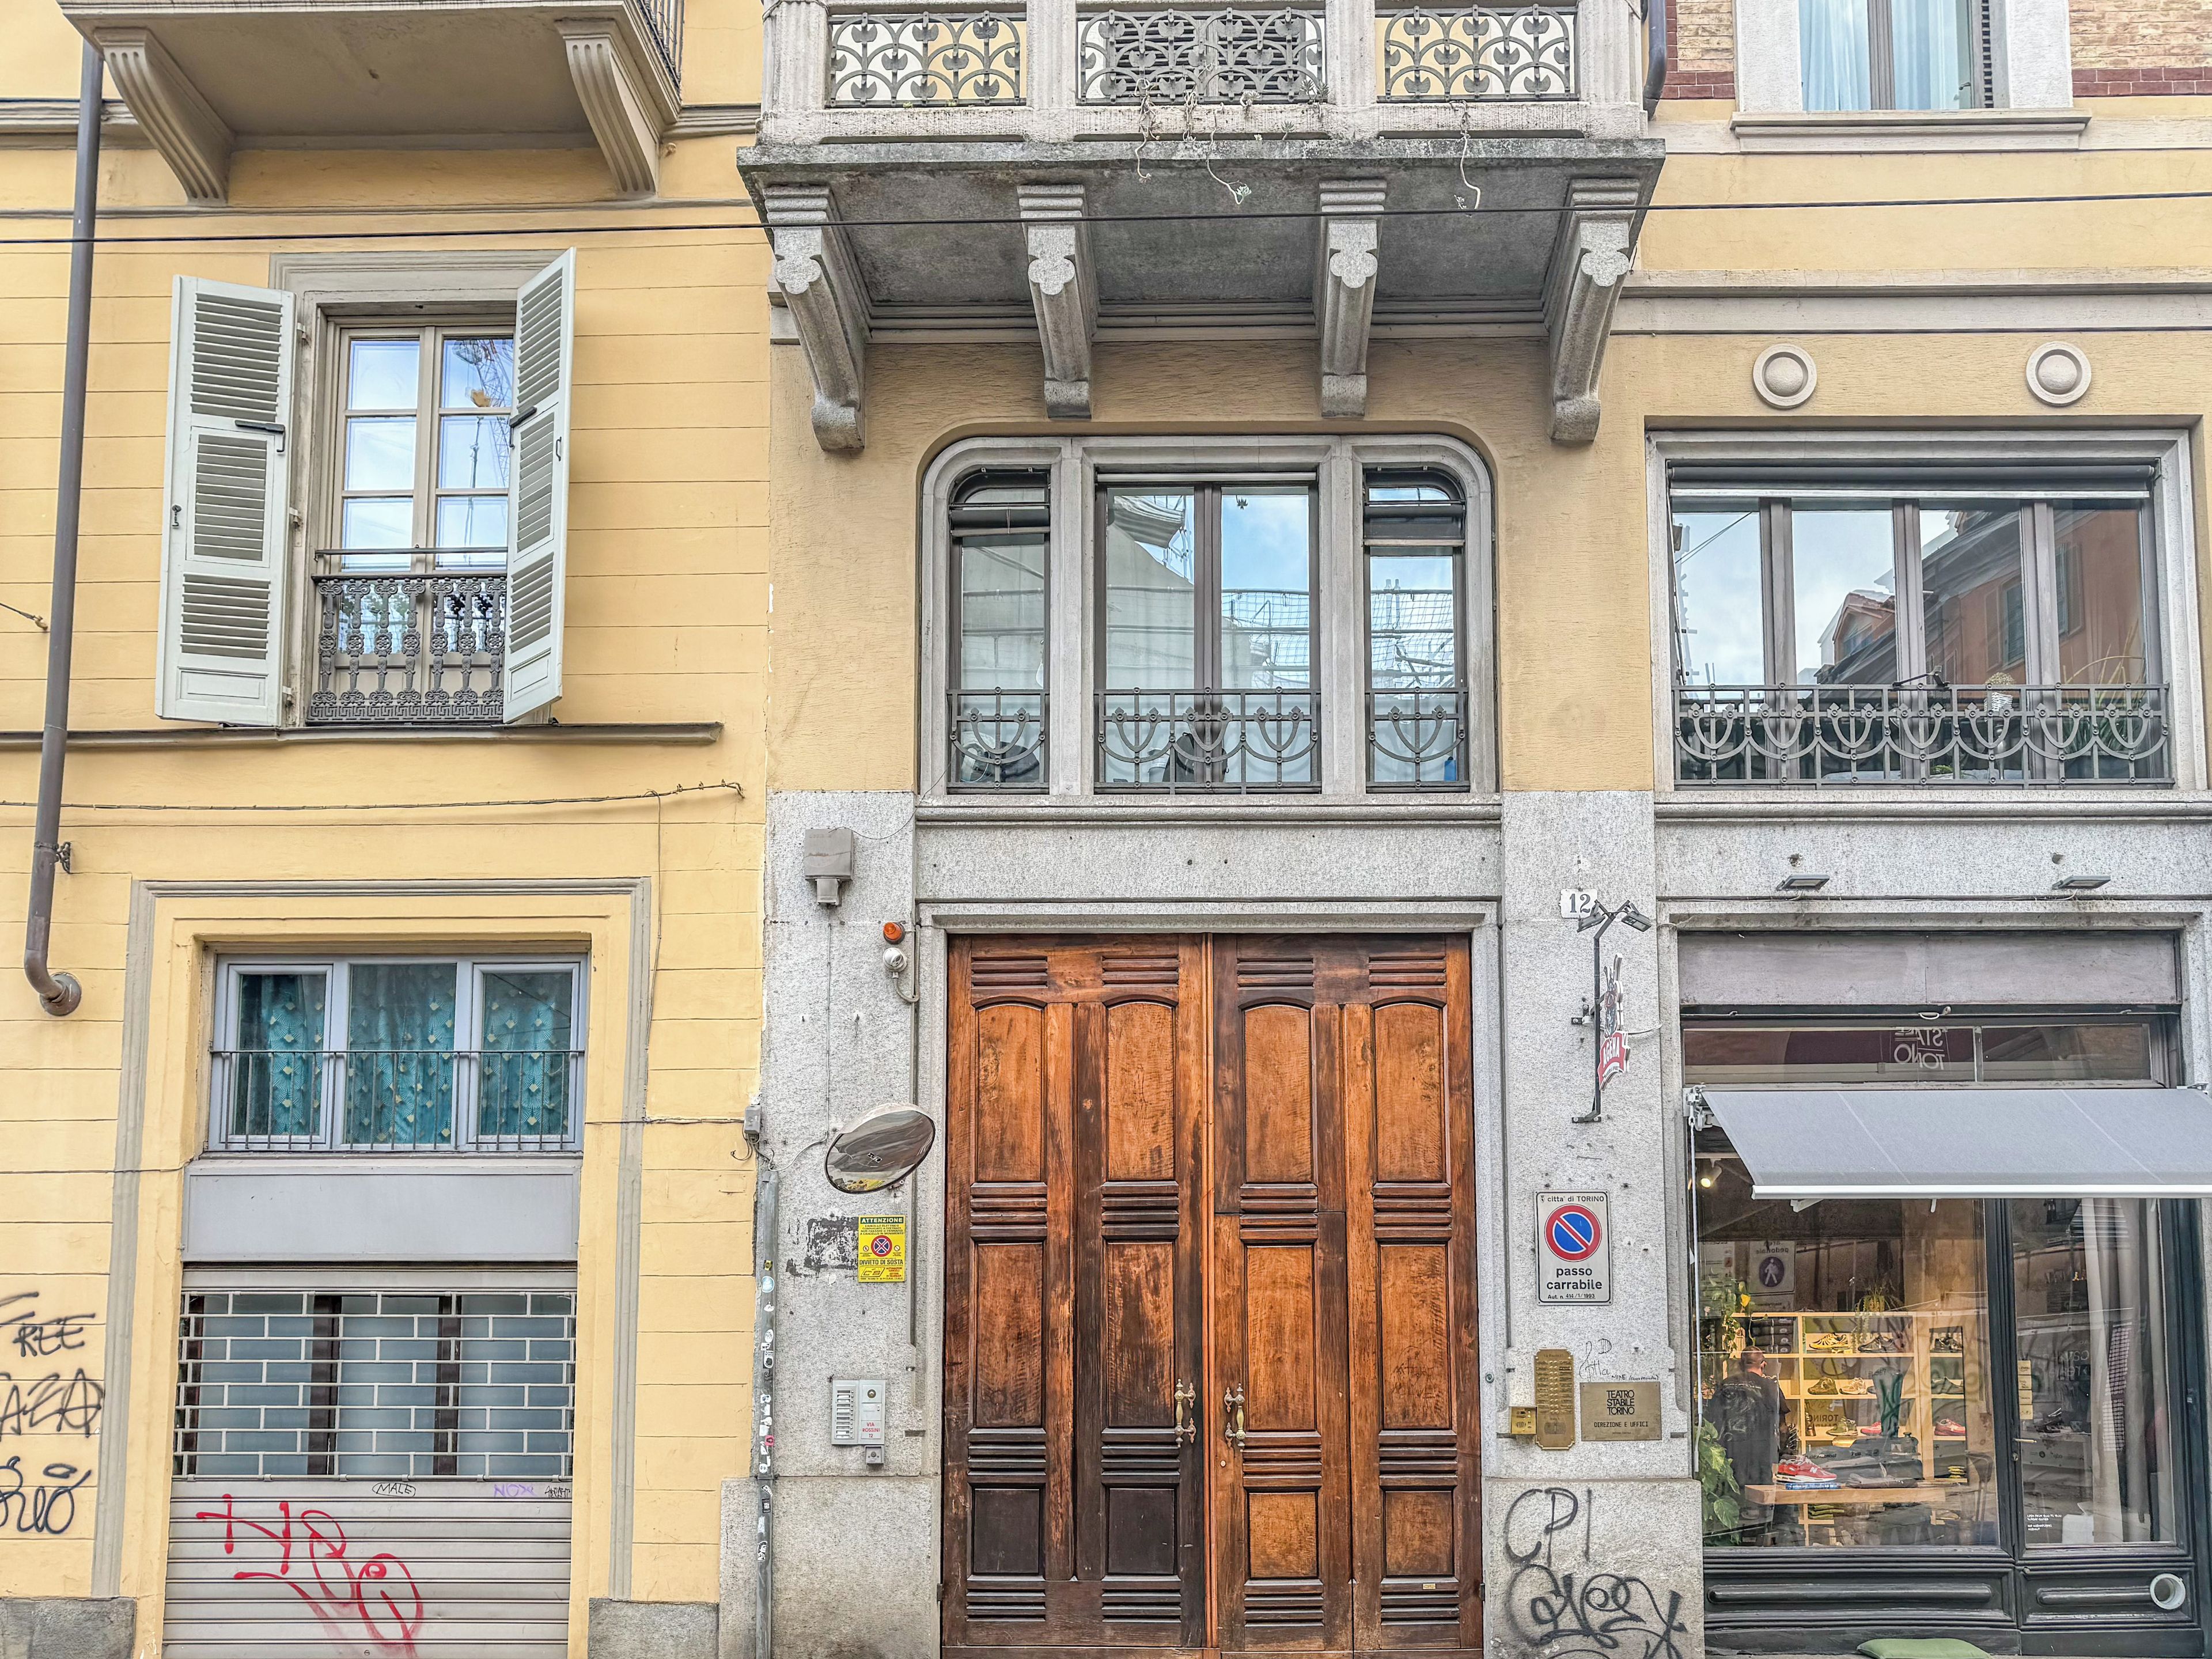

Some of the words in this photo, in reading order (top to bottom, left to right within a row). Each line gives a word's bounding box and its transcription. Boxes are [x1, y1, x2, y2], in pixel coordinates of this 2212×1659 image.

[1570, 893, 1590, 913] 12
[1556, 1268, 1592, 1278] passo
[1547, 1279, 1603, 1289] carrabile
[1606, 1389, 1635, 1398] TEATRO
[1607, 1398, 1635, 1406] STABILE
[1607, 1406, 1635, 1415] TORINO
[376, 1483, 412, 1494] MALE
